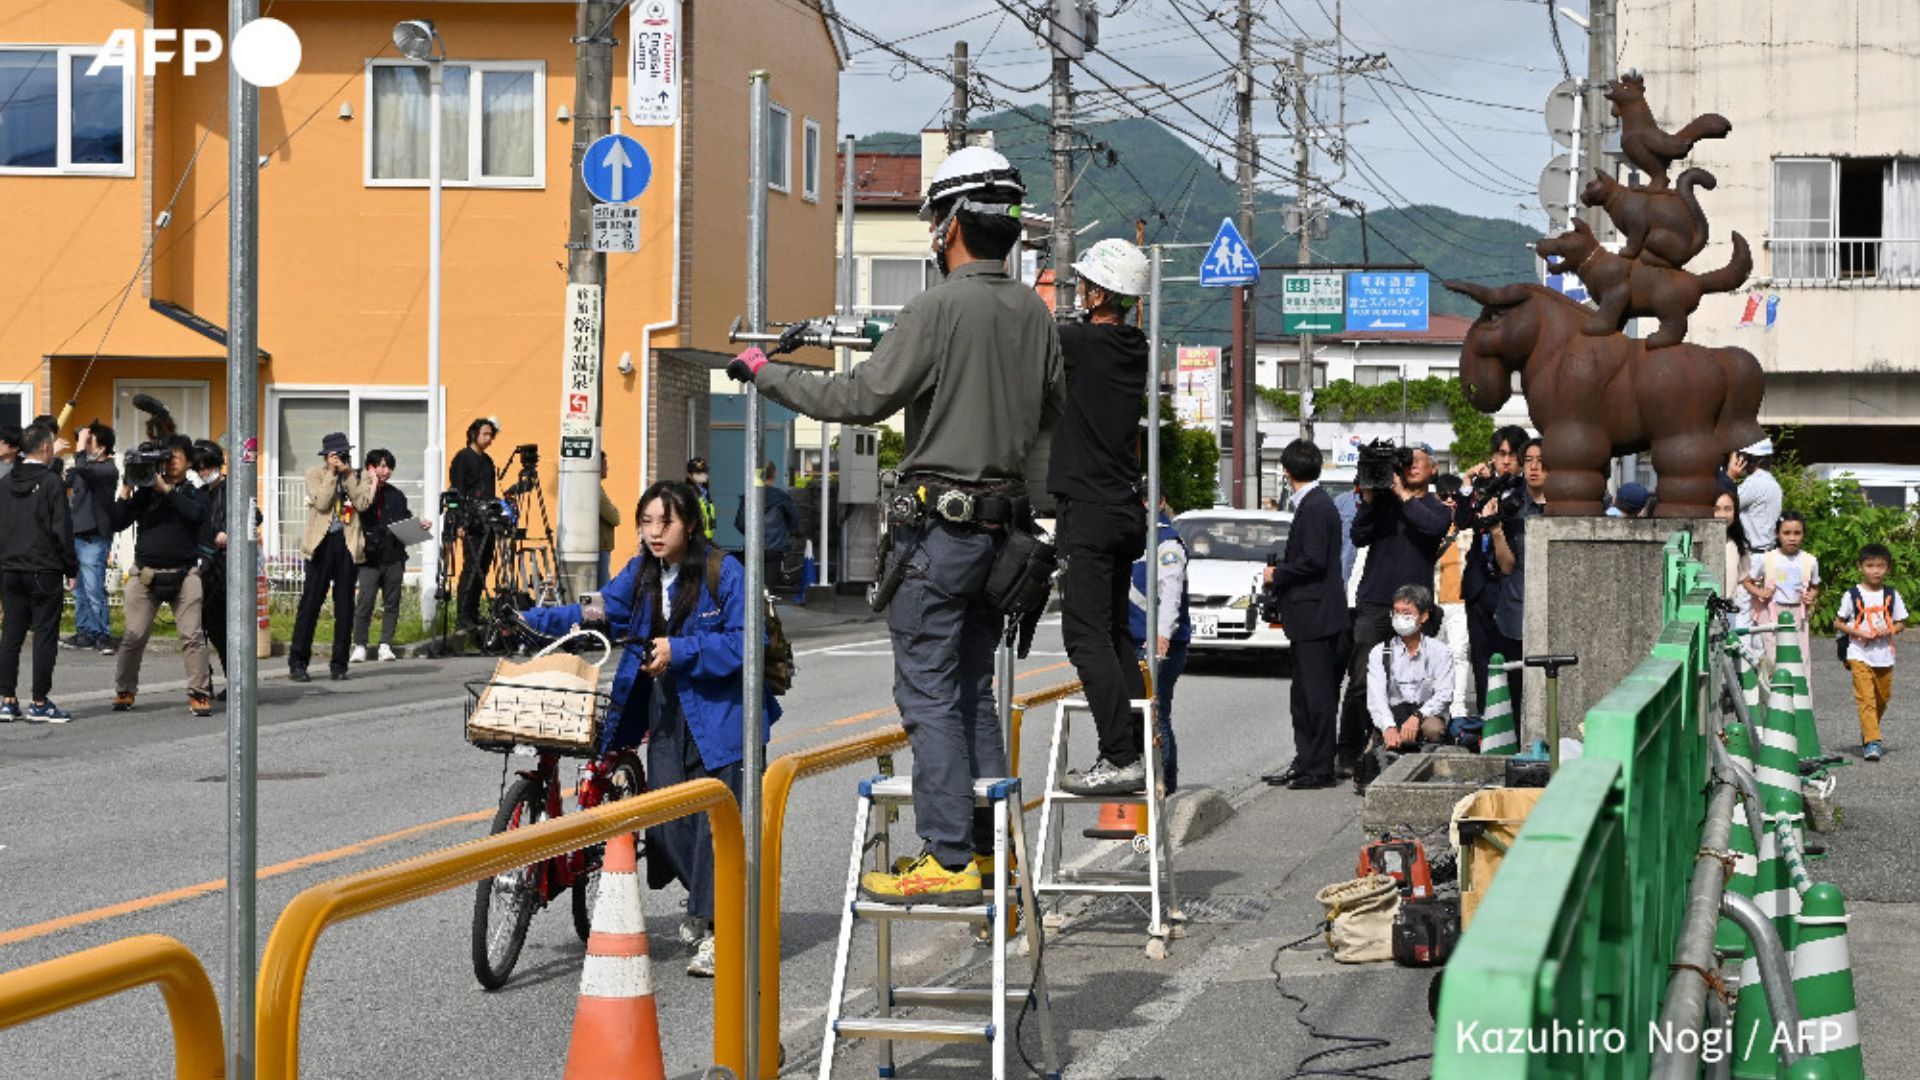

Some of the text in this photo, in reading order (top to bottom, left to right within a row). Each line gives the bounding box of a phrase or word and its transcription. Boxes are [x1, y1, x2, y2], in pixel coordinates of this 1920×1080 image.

[636, 32, 649, 70] Camp
[648, 32, 661, 78] English
[1360, 276, 1416, 287] 有料道路
